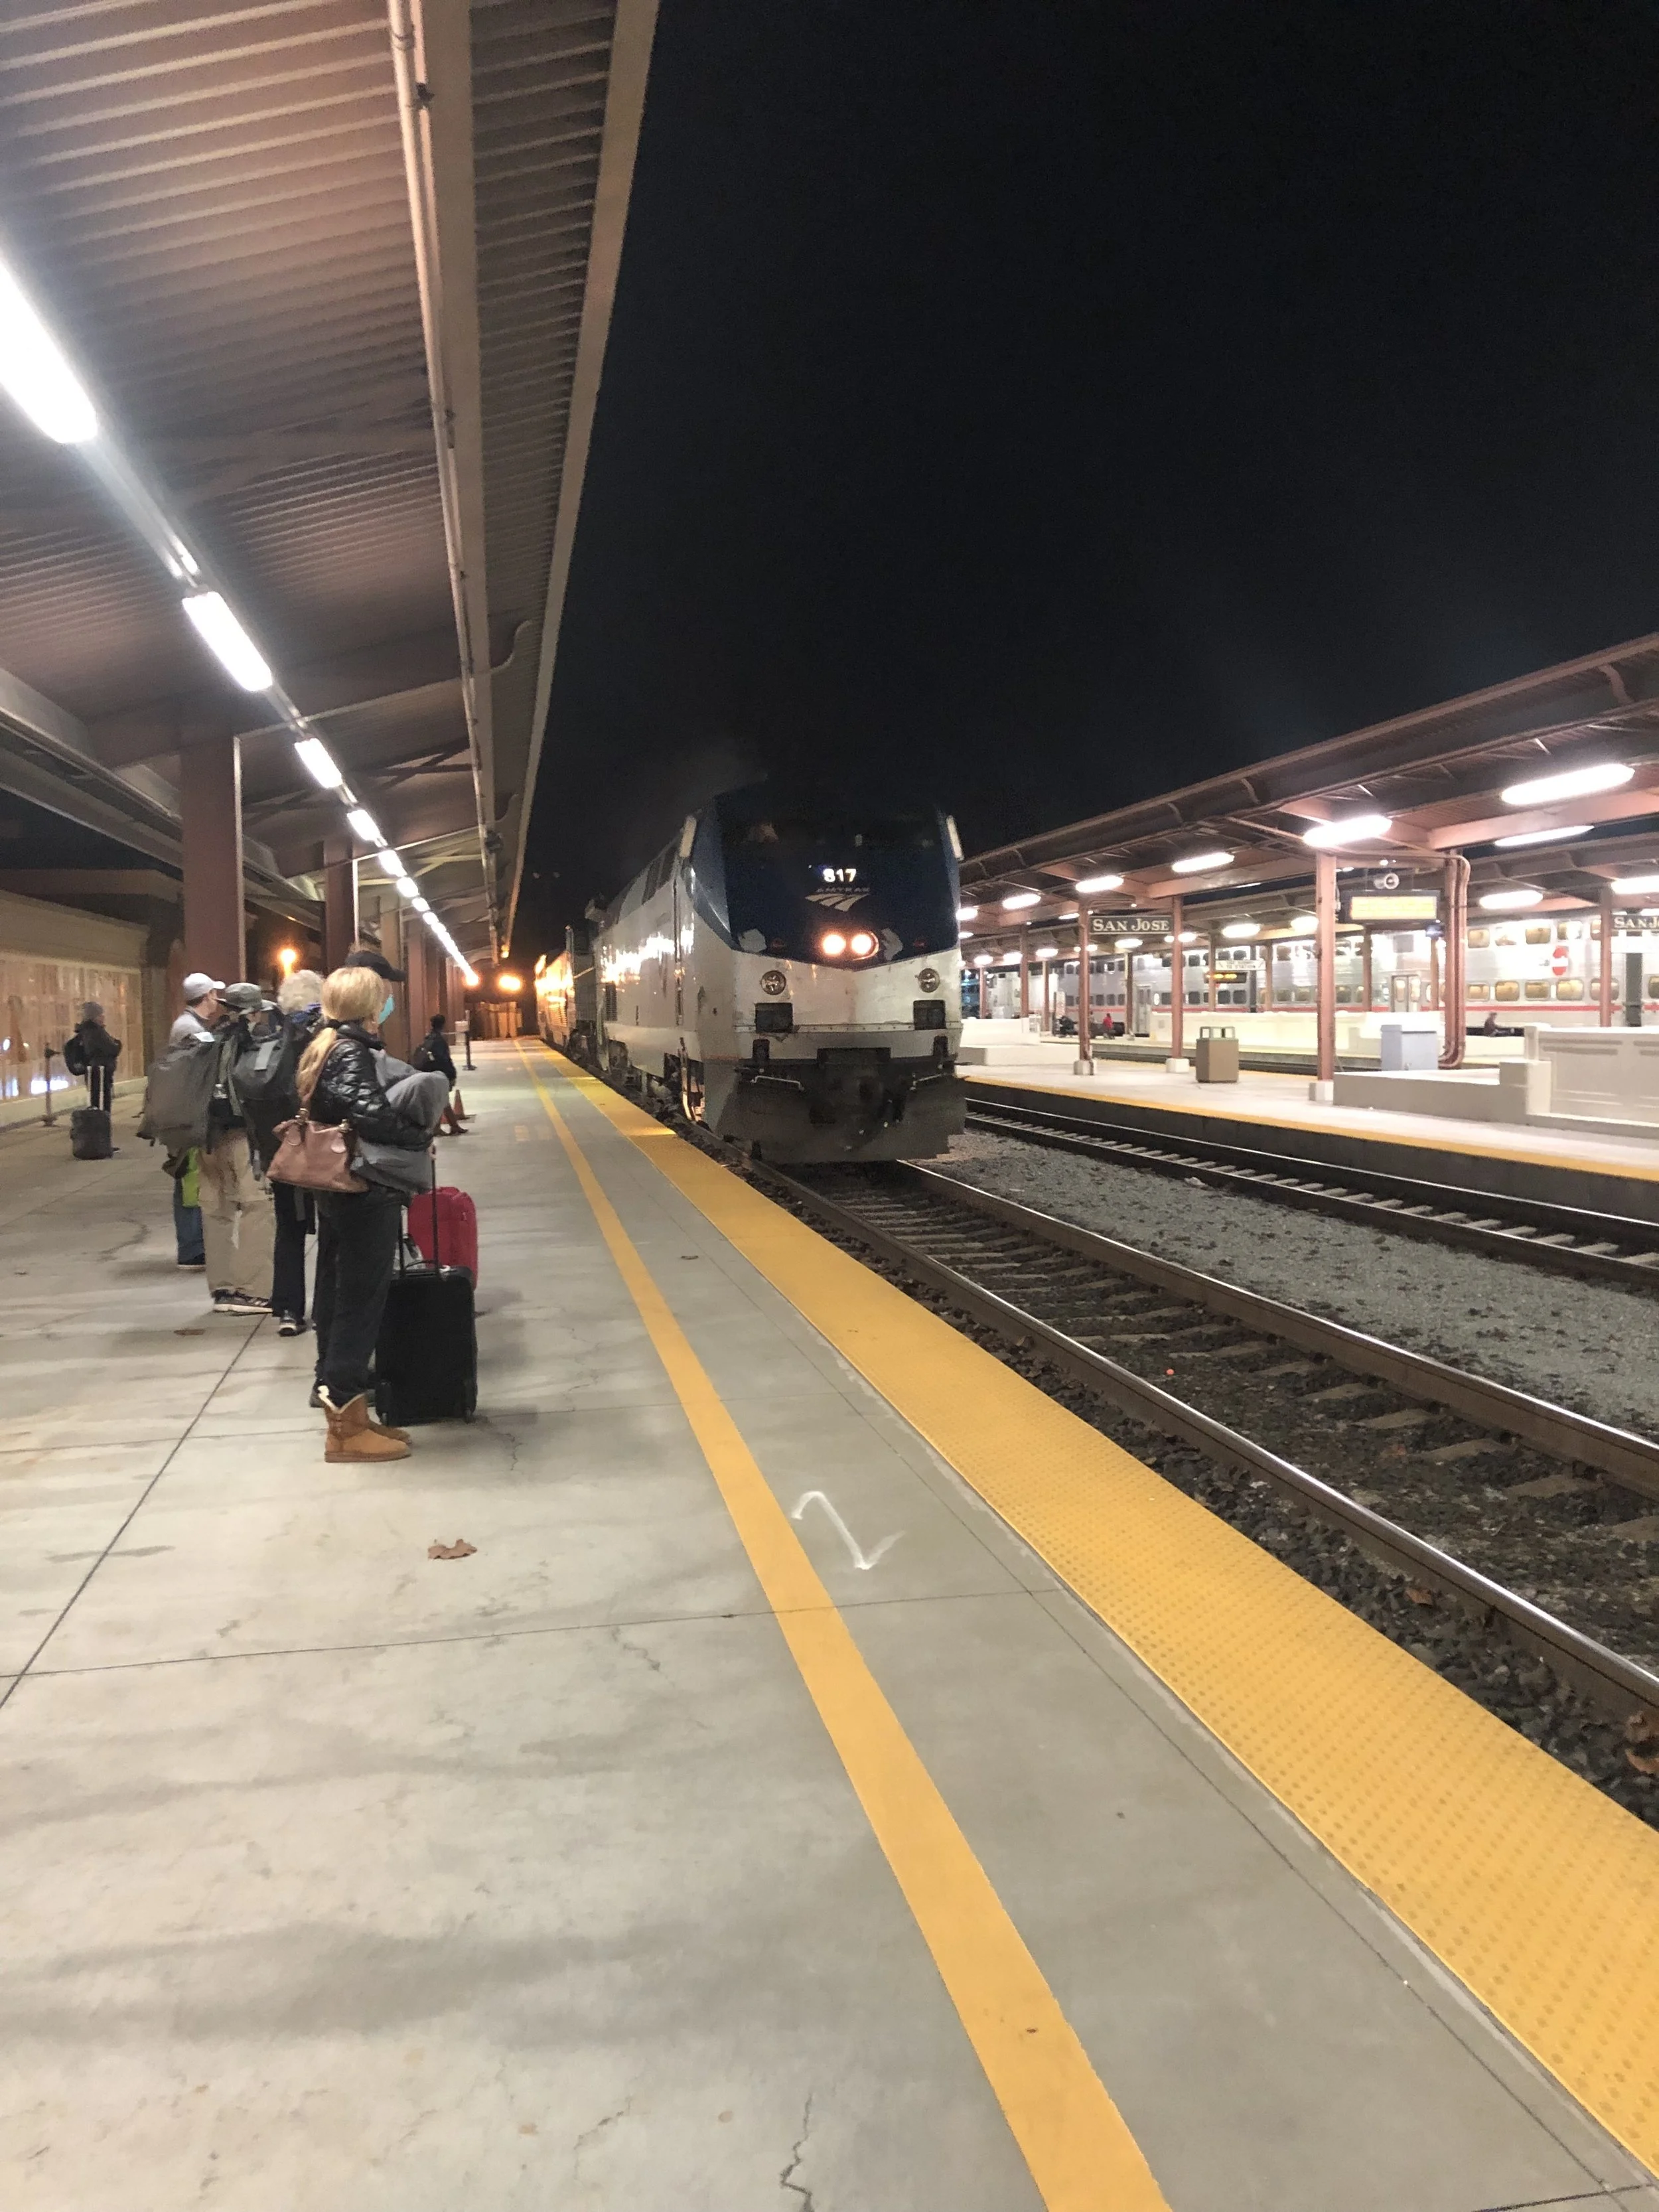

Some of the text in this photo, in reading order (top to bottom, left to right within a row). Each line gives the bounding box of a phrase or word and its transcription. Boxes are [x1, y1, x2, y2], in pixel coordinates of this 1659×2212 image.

[823, 868, 857, 883] 817
[1092, 919, 1169, 931] SAN JOSE
[1614, 917, 1648, 928] SAN
